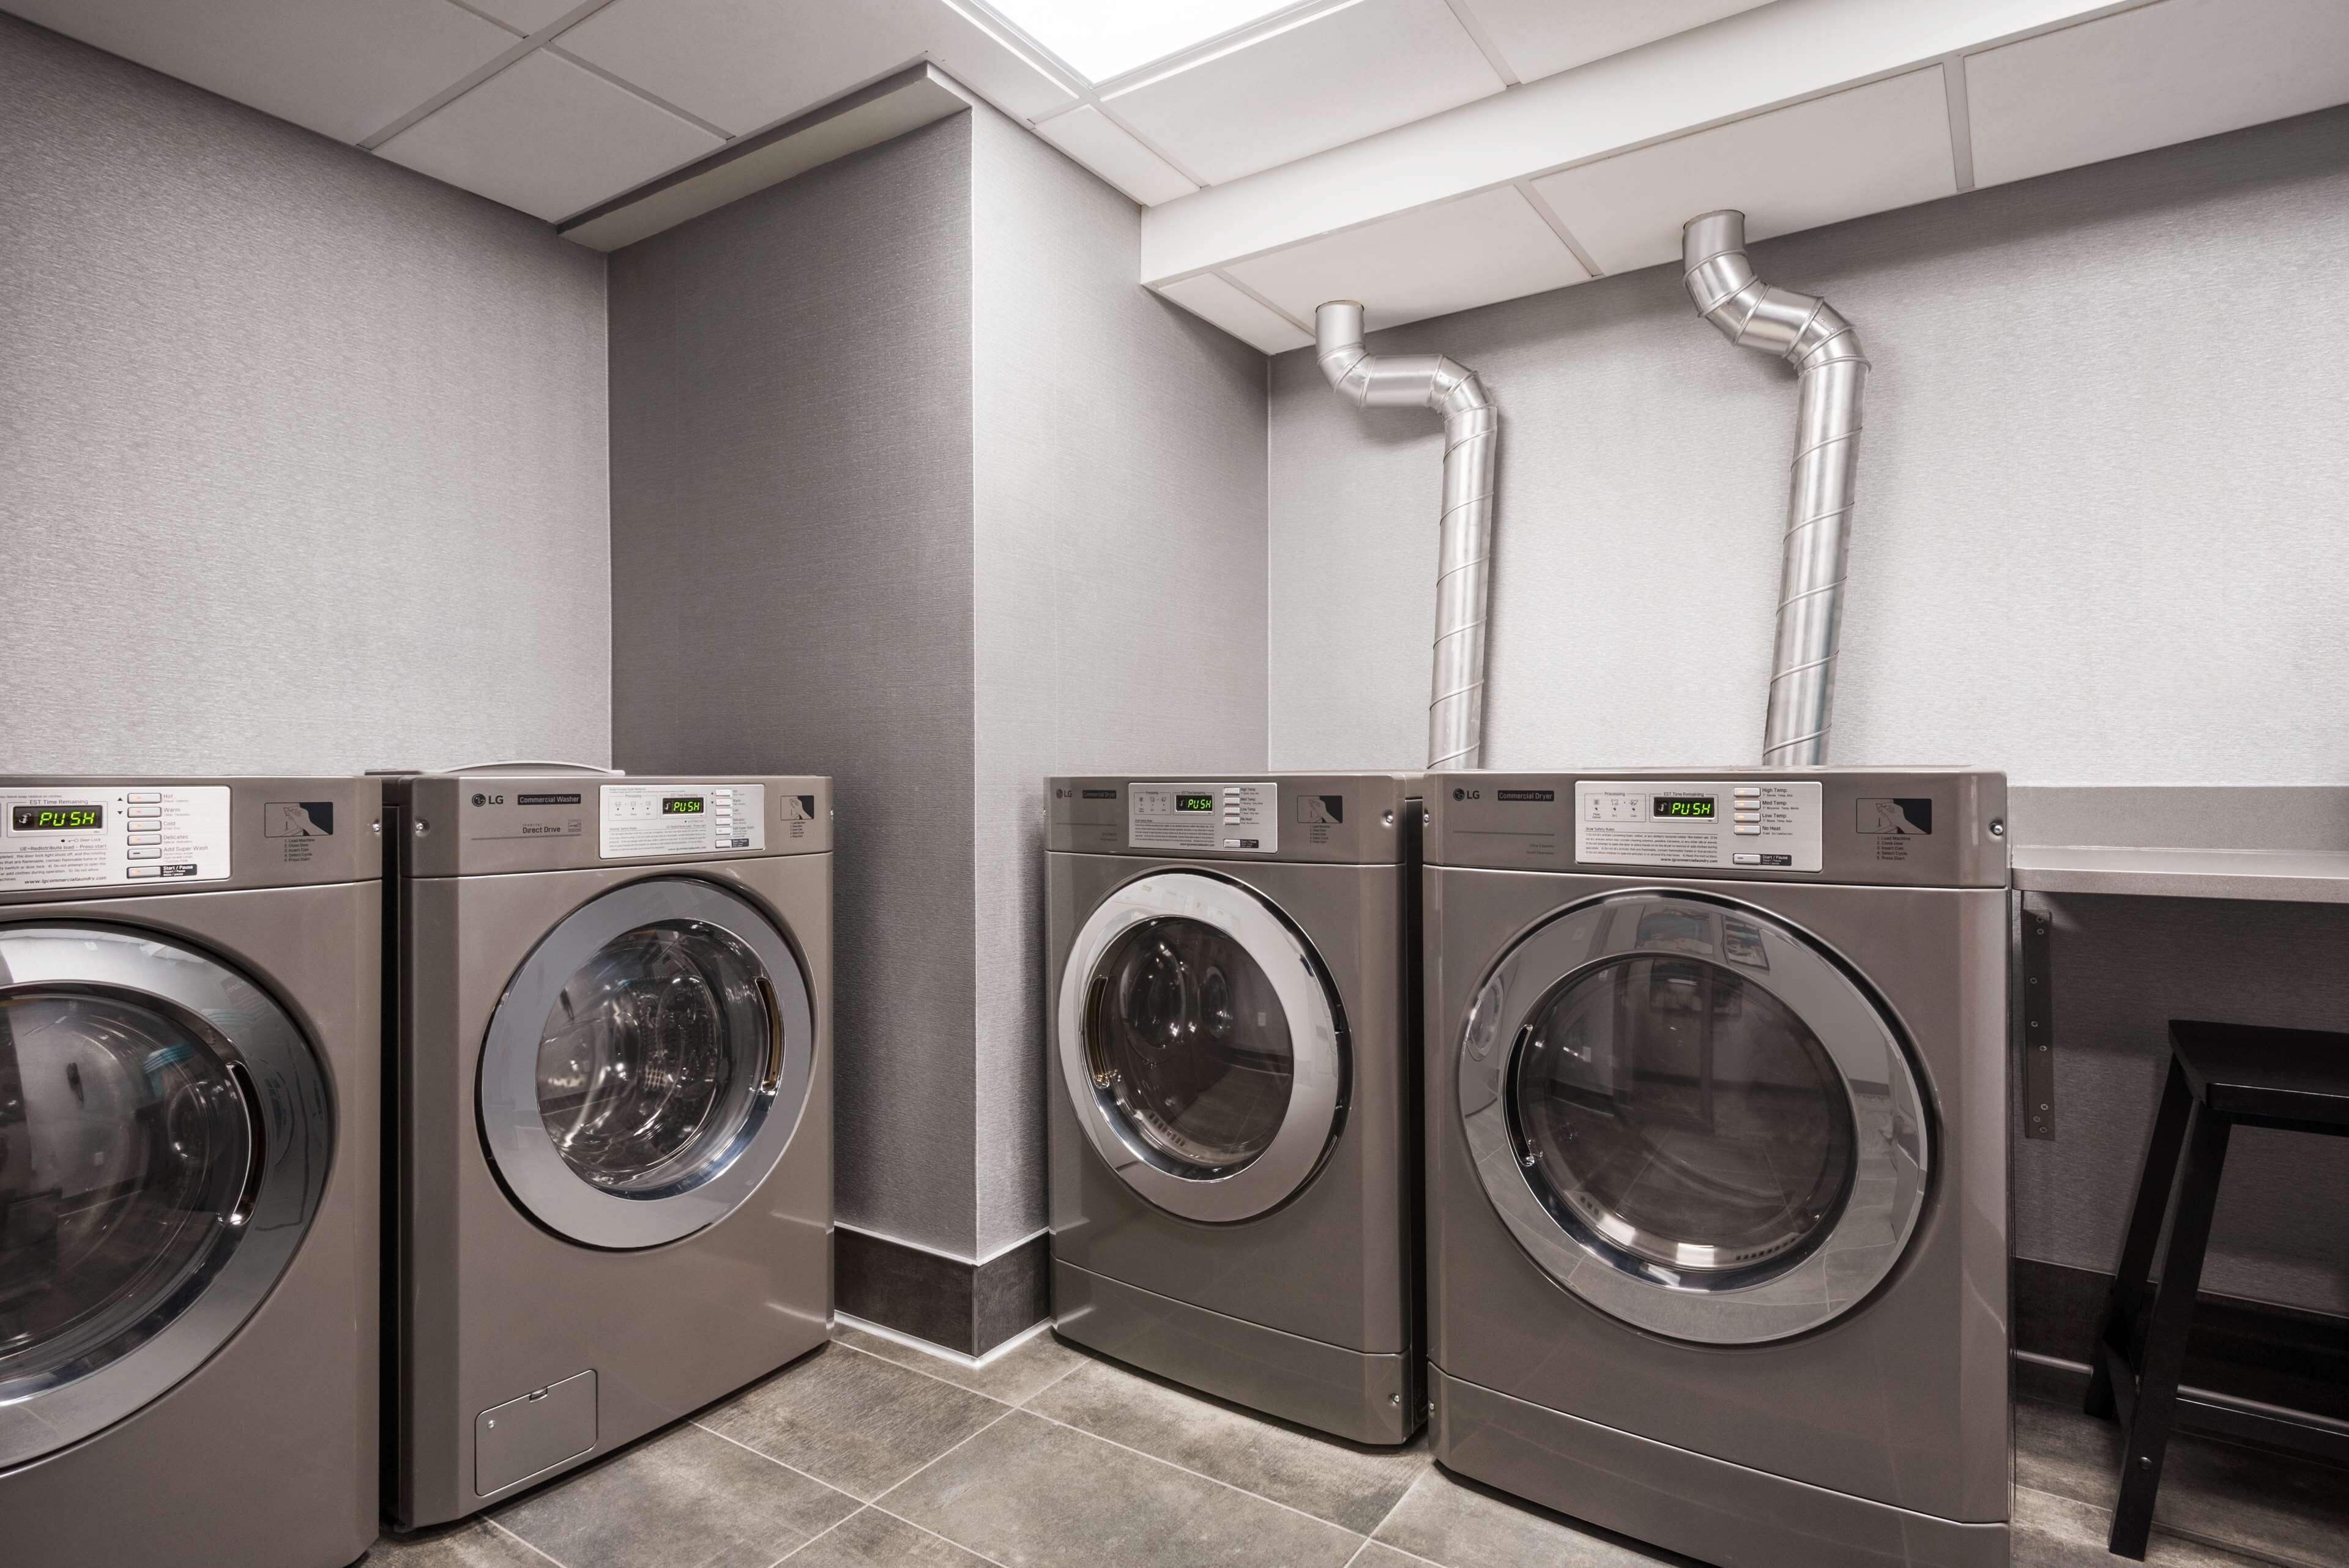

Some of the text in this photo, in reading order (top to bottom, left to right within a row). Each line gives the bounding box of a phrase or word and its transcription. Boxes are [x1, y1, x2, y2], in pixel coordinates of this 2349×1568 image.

[489, 795, 504, 804] LG
[1467, 790, 1480, 799] LG
[674, 801, 700, 812] PUSH
[1188, 799, 1212, 809] PUSH
[1672, 803, 1711, 815] PUSH
[39, 811, 95, 827] PUSH
[24, 875, 107, 885] www.lgcommerciallaundry.com
